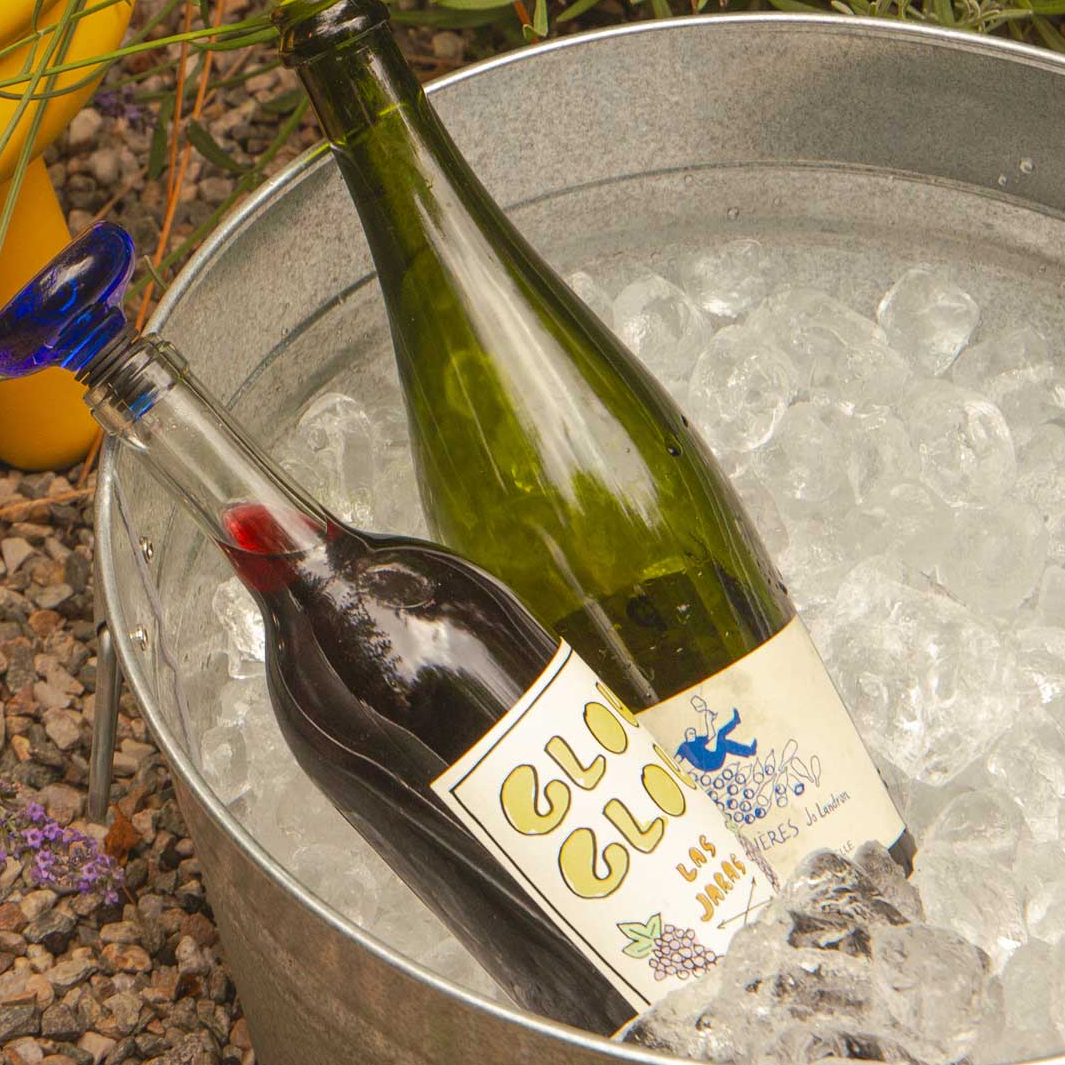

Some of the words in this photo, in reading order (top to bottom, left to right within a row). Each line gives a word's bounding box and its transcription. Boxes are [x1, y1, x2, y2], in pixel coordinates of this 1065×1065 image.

[804, 805, 818, 827] Jo
[676, 834, 716, 883] LAS
[695, 853, 747, 923] JARAS
